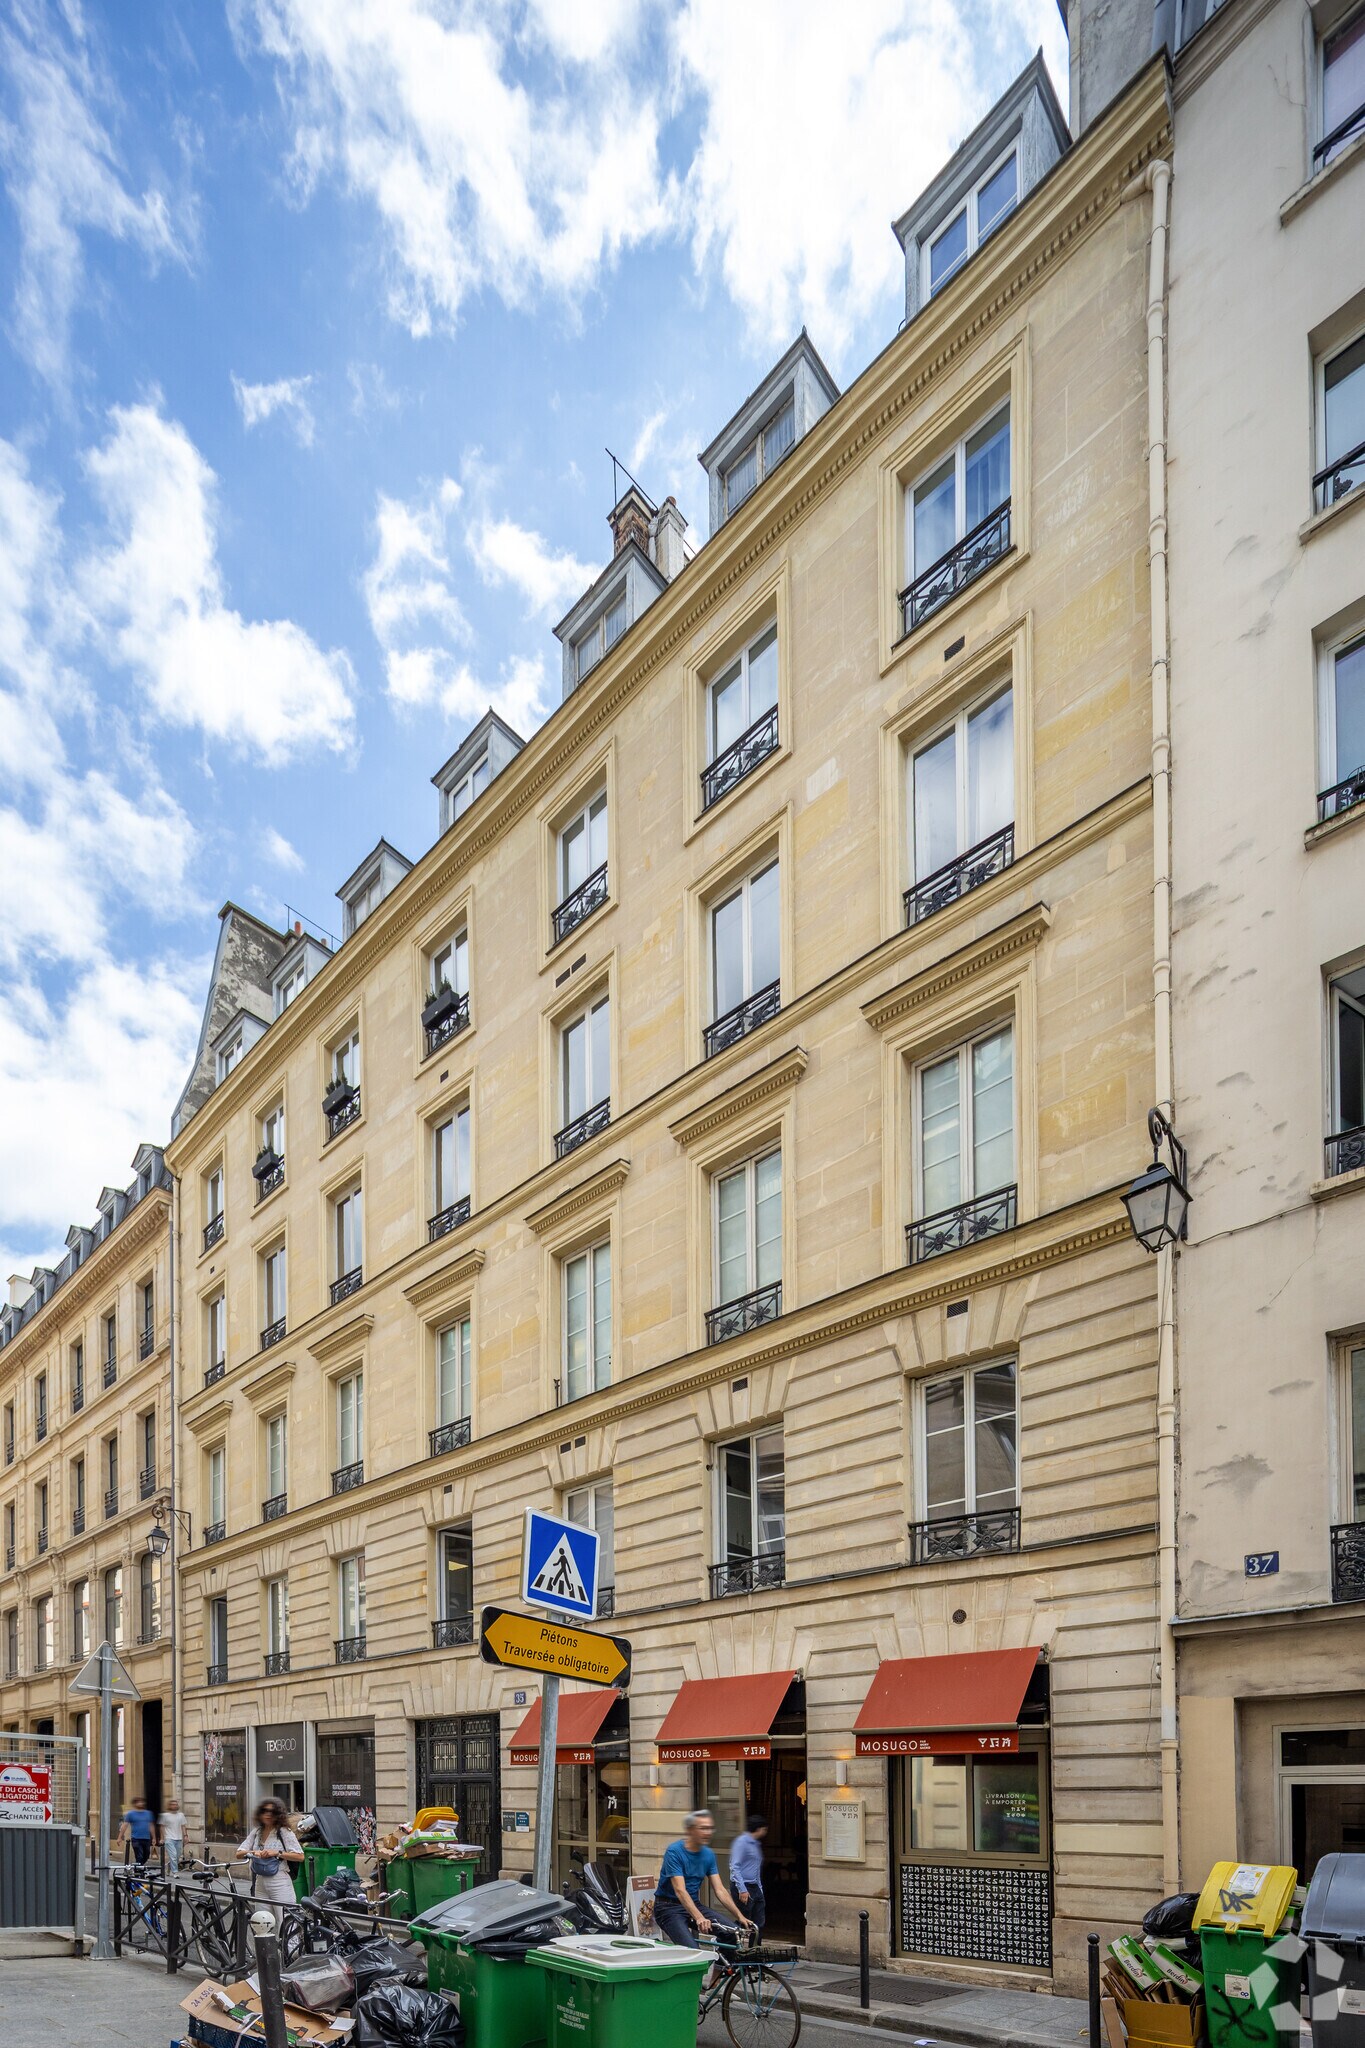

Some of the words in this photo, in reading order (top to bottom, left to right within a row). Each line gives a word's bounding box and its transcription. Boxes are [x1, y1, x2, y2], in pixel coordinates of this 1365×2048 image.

[1249, 1555, 1273, 1573] 37
[540, 1628, 578, 1648] Piétons
[503, 1641, 575, 1663] Traversée
[558, 1655, 609, 1675] obligatoire
[515, 1693, 525, 1703] 35
[265, 1738, 296, 1751] TEXBROD
[861, 1740, 918, 1751] MOSUGO
[513, 1754, 540, 1762] MOSUG
[662, 1749, 702, 1759] MOSUGO
[17, 1787, 46, 1795] CASQUE
[9, 1813, 44, 1821] CHANTIER
